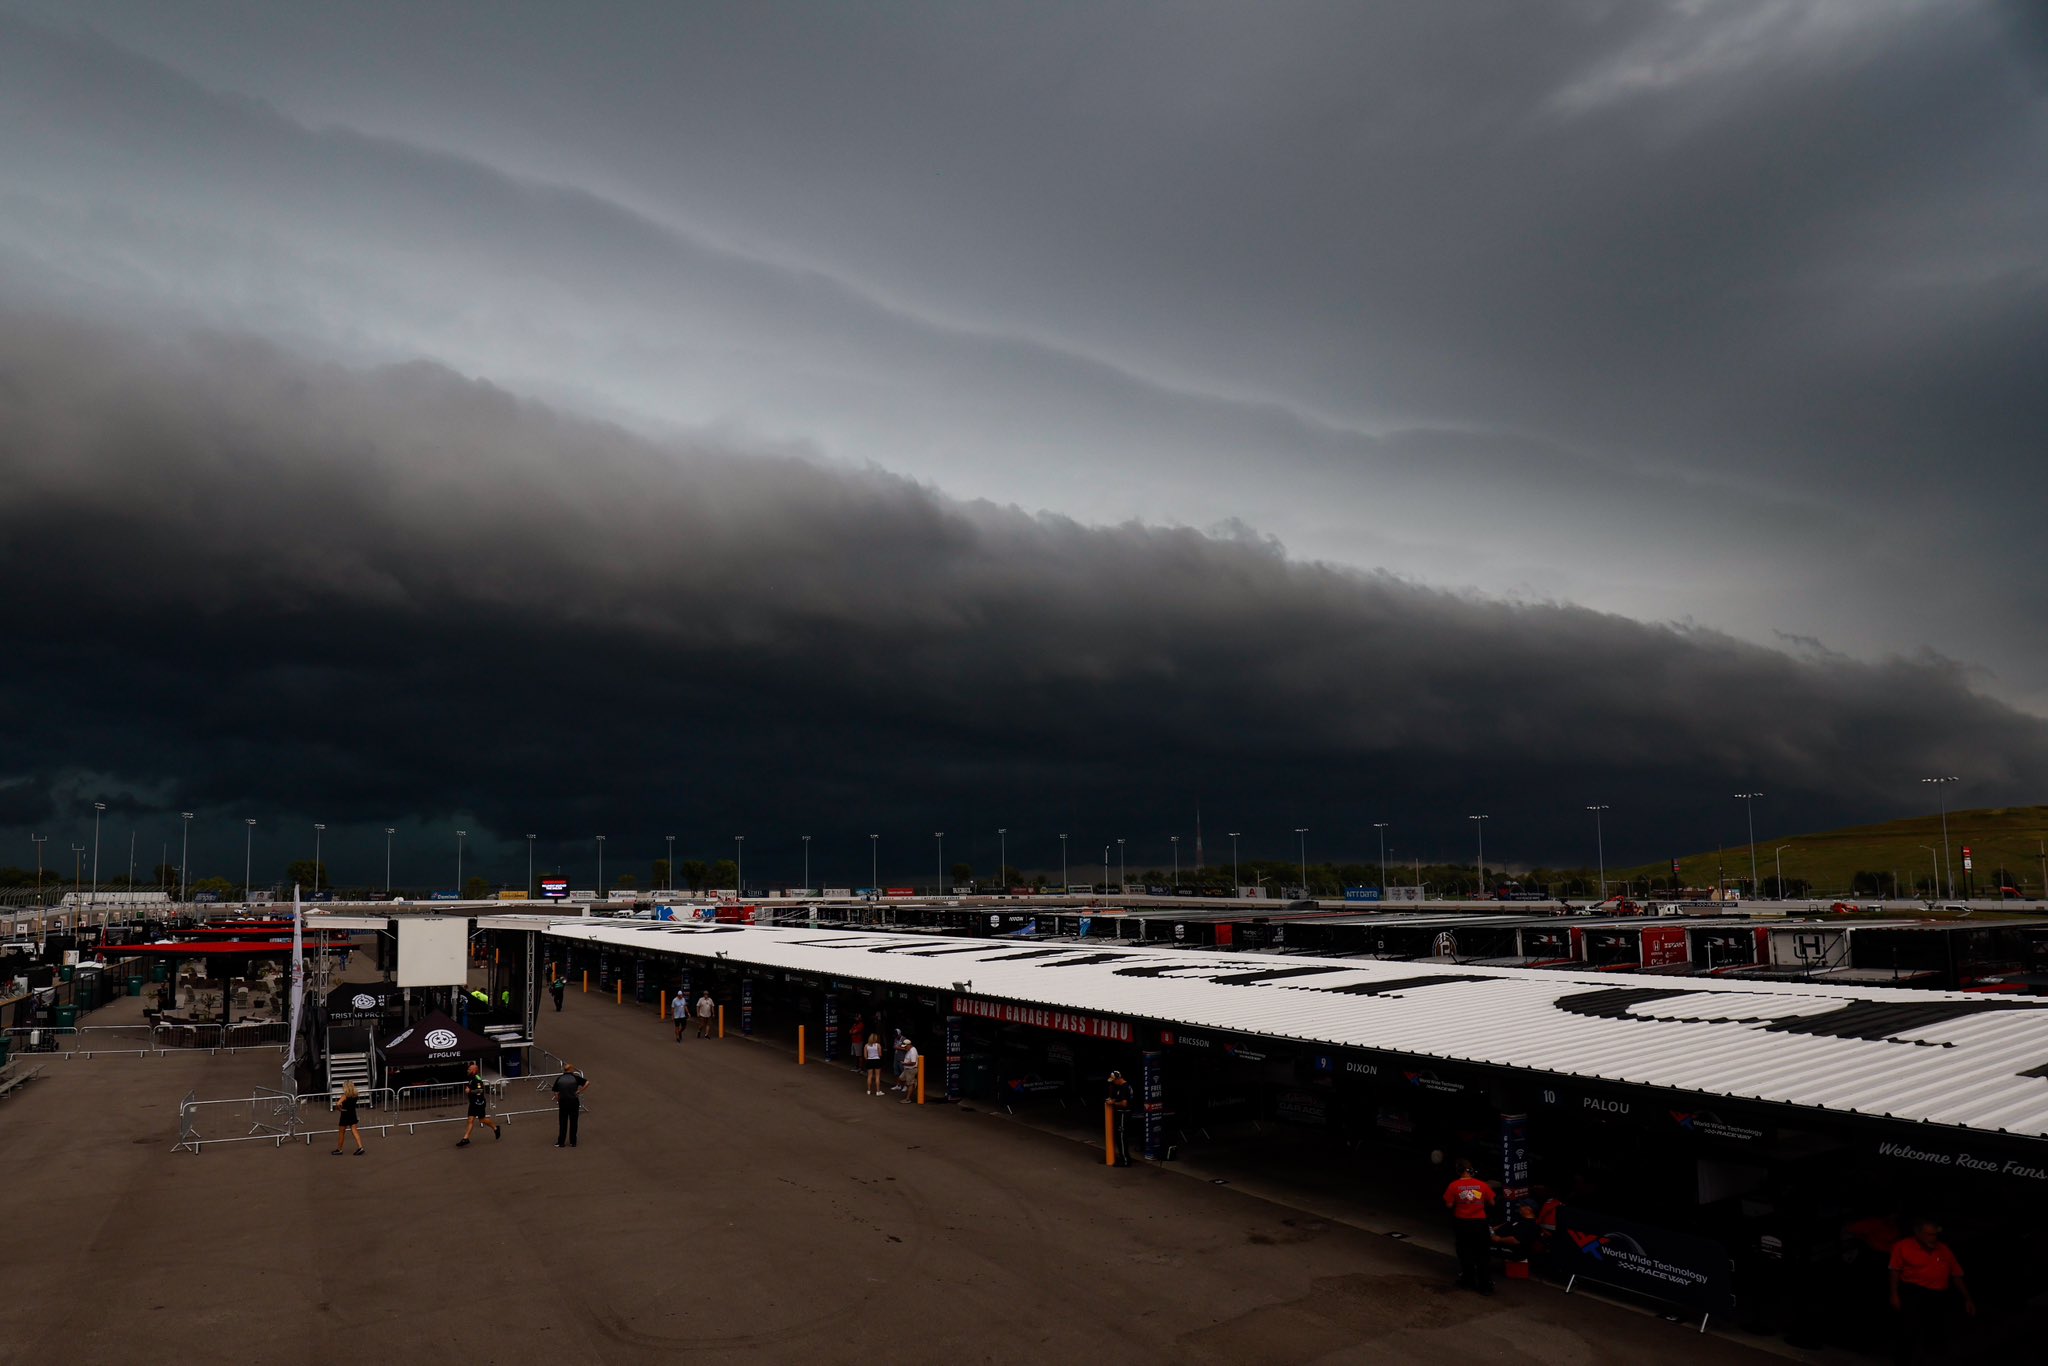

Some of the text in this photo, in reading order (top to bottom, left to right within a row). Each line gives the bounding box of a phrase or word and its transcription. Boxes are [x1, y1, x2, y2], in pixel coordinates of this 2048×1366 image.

[330, 1012, 363, 1020] TRISTAR
[956, 998, 1129, 1040] GATEWAY GARAGE PASS THRU
[1178, 1036, 1210, 1048] ERICSSON
[428, 1051, 461, 1059] #TPGLIVE
[1320, 1057, 1378, 1075] 9 DIXON
[1543, 1090, 1630, 1114] 10 PALOU
[1693, 1120, 1710, 1128] World
[1727, 1123, 1763, 1137] Technology
[1879, 1141, 1951, 1165] Welcome
[1955, 1153, 1999, 1172] Race
[1513, 1161, 1528, 1172] FREE
[1514, 1170, 1528, 1181] WIFI
[1601, 1246, 1708, 1285] World Wide Technology
[1637, 1265, 1692, 1286] RACEWAY
